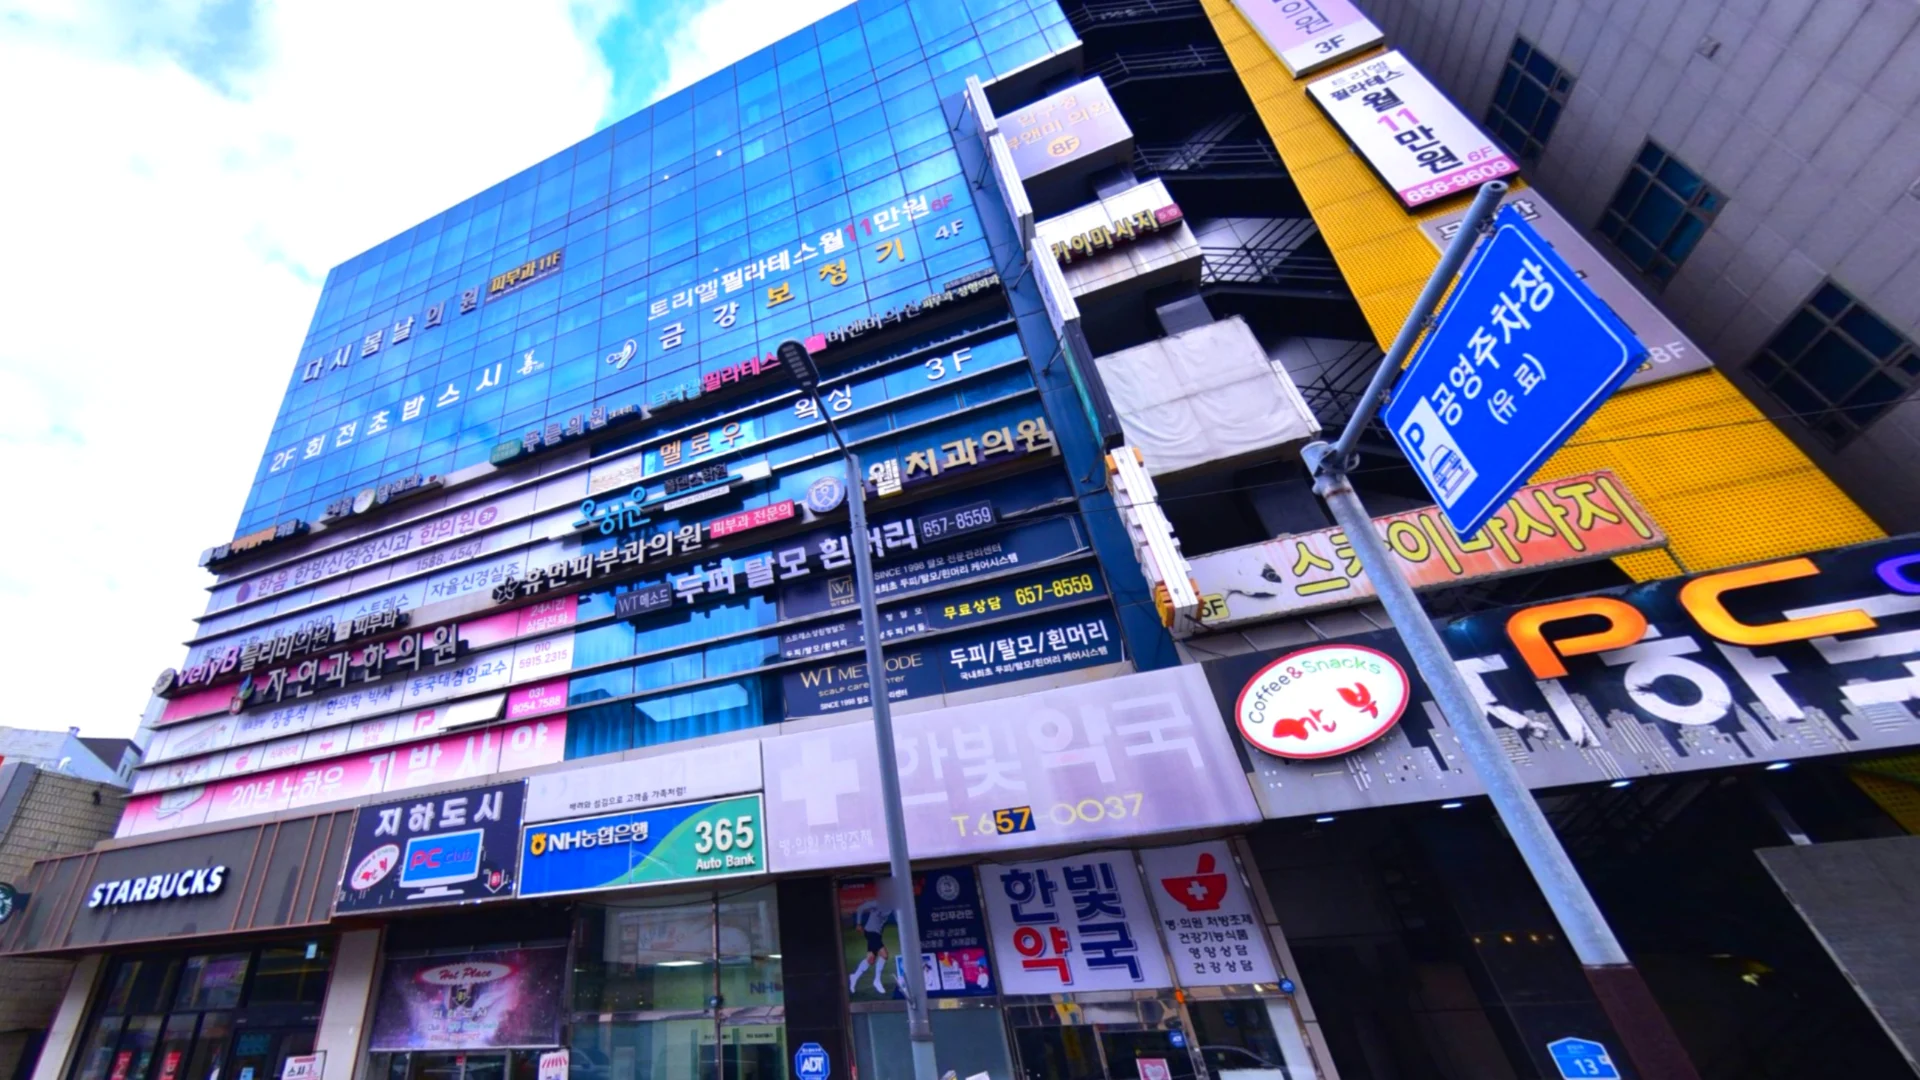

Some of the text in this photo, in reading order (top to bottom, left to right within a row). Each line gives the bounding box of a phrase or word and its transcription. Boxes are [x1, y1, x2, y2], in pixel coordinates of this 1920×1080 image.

[1315, 34, 1346, 55] 3F
[1329, 69, 1405, 101] 필라테스
[1052, 138, 1076, 154] 8F
[1467, 145, 1493, 164] 6F
[1405, 160, 1511, 204] 656-9609
[931, 193, 953, 213] 6F
[934, 220, 965, 240] 4F
[491, 261, 536, 293] 피부과
[1431, 258, 1555, 427] 공영주차장
[1648, 340, 1686, 364] 8F
[703, 352, 781, 393] 필라테스
[660, 347, 973, 467] 멜로우 왁싱 3F
[522, 405, 607, 452] 푸른의원
[1404, 421, 1426, 463] P
[270, 448, 297, 473] 2F
[420, 509, 477, 546] 한의원
[480, 510, 495, 524] 3F
[521, 502, 793, 595] 휴먼피부과의원 피부과 전문의
[676, 558, 736, 604] 두피
[744, 546, 811, 589] 탈모
[922, 506, 992, 538] 657-8559
[874, 568, 901, 582] SINCE
[943, 574, 1093, 620] 무료상담 657-8559
[354, 609, 400, 636] 피부과
[526, 612, 568, 633] 상담전화
[1507, 557, 1878, 680] PC
[519, 649, 568, 669] 5915.2315
[534, 641, 552, 653] 010
[950, 619, 1109, 670] 두피/탈모/흰머리
[263, 623, 457, 702] 자연과한의원
[800, 666, 836, 688] WT
[528, 687, 545, 699] 031
[231, 780, 276, 811] 20년
[282, 766, 344, 802] 노하우
[374, 791, 505, 837] 지하도시
[695, 816, 755, 854] 365
[410, 848, 443, 871] PC
[695, 854, 756, 872] Auto Bank
[88, 865, 227, 908] STARBUCKS
[1000, 863, 1126, 924] 한빛
[1179, 928, 1249, 945] 건강기능식품
[1206, 912, 1253, 929] 처방조제
[1013, 922, 1143, 985] 약국
[802, 1056, 825, 1073] ADT
[1574, 1057, 1600, 1076] 13
